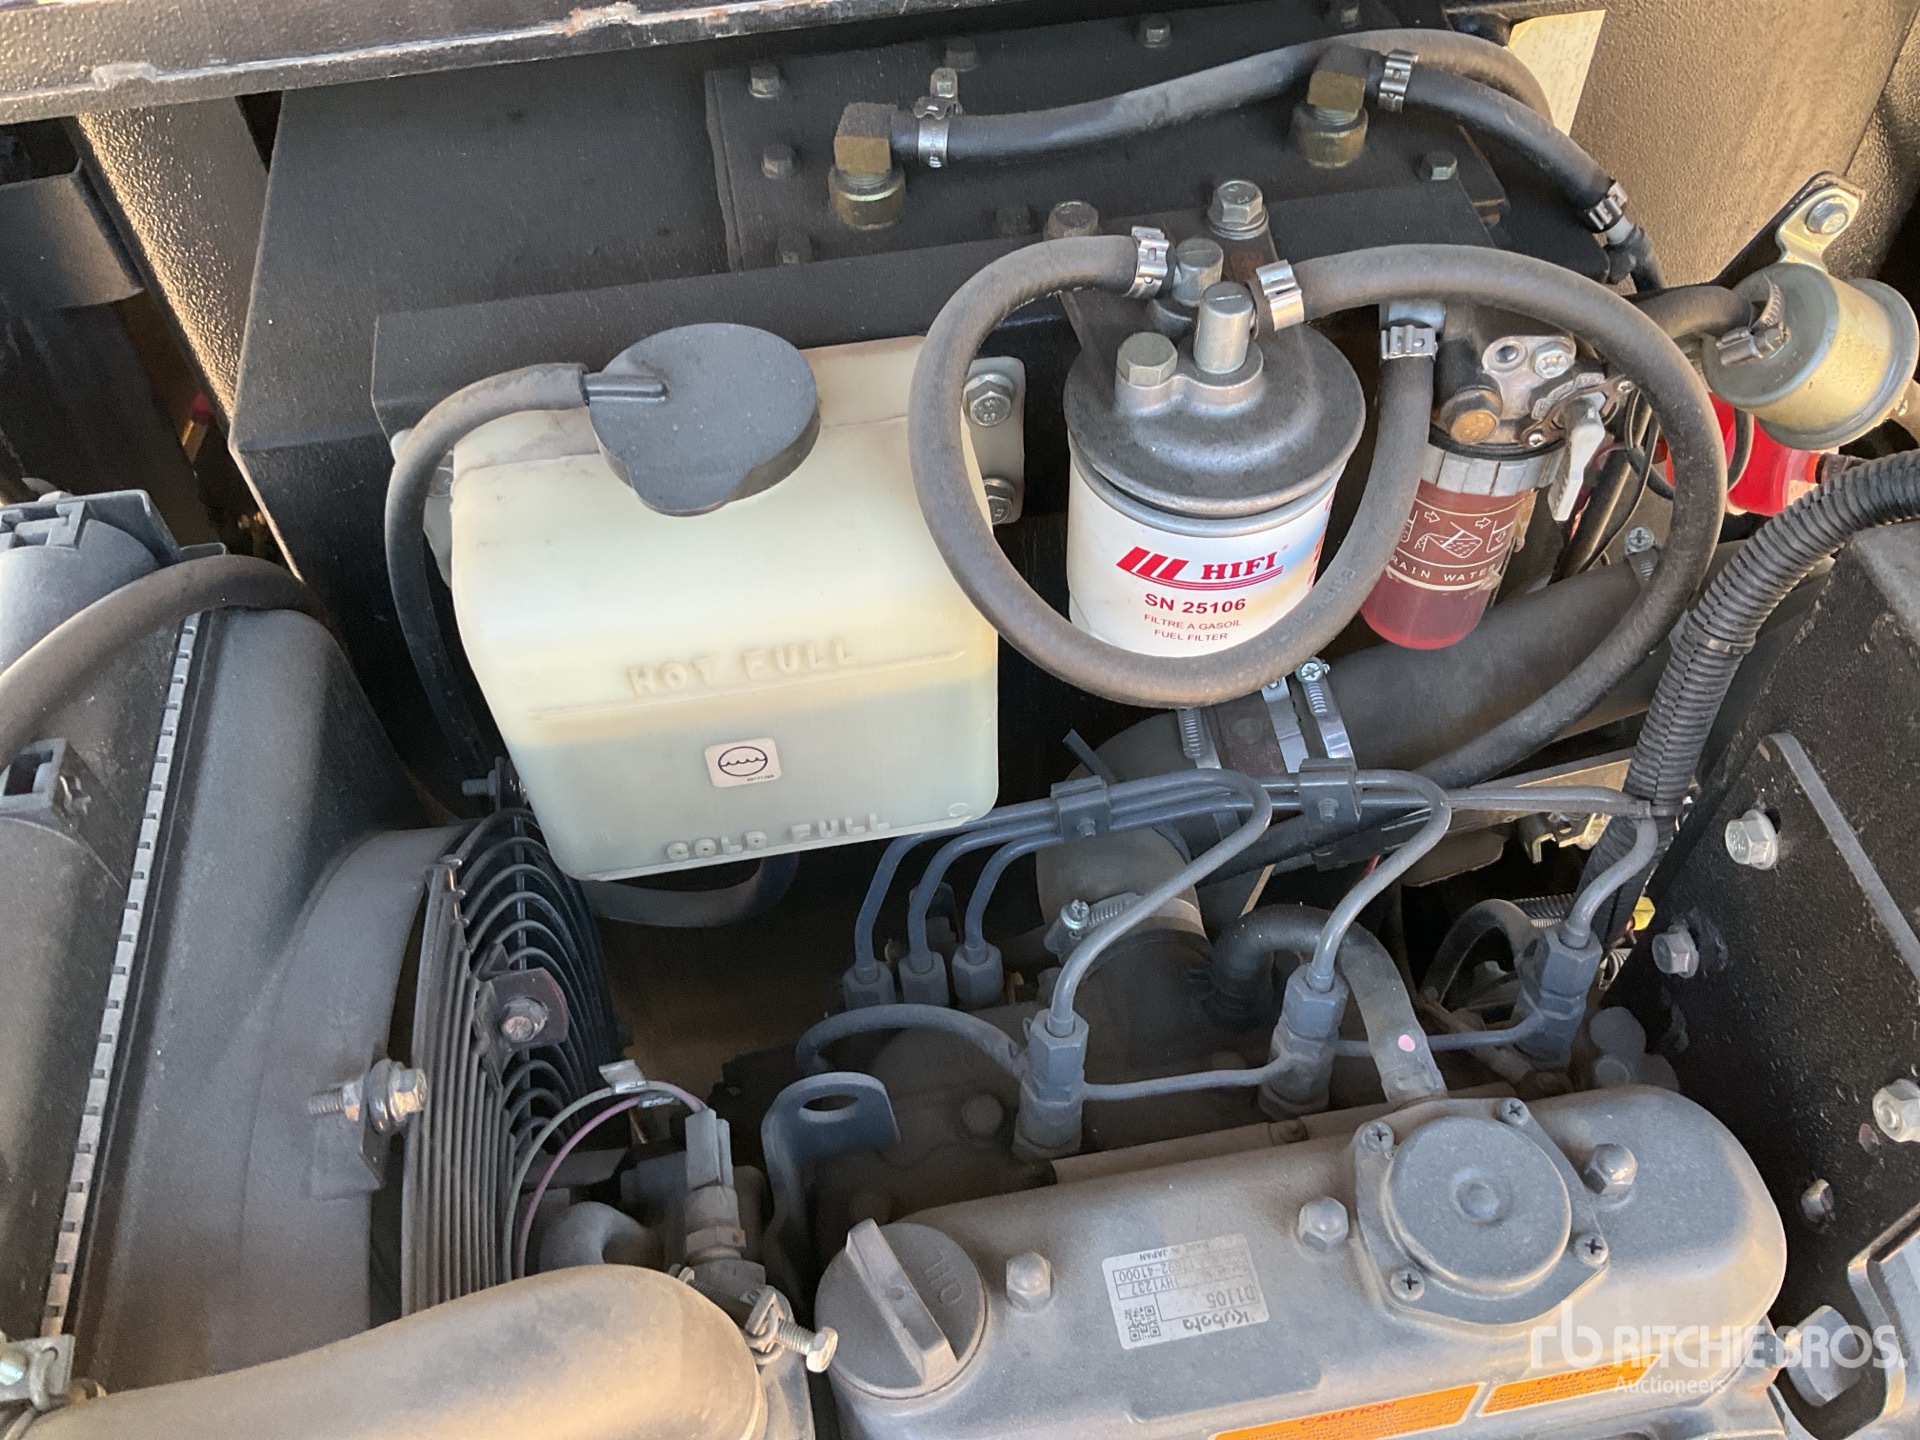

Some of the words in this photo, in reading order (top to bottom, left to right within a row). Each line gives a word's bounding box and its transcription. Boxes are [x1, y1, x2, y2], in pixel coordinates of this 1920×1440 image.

[1200, 551, 1278, 580] HIFI
[1391, 554, 1431, 579] RAIN
[1144, 593, 1175, 611] SN
[1182, 598, 1246, 615] 25106
[1144, 613, 1184, 630] FILTRE
[1187, 622, 1196, 630] A
[1198, 619, 1242, 631] GASOIL
[1154, 629, 1184, 641] FUEL
[1187, 632, 1229, 642] FILTER
[626, 655, 716, 697] HOT
[742, 639, 857, 680] FULL
[667, 830, 769, 862] COLD
[791, 812, 890, 844] FULL
[1138, 1249, 1168, 1262] JAPAN
[1206, 1284, 1256, 1310] D1105
[1182, 1309, 1250, 1333] Kubota
[1299, 1402, 1397, 1426] CAUTION
